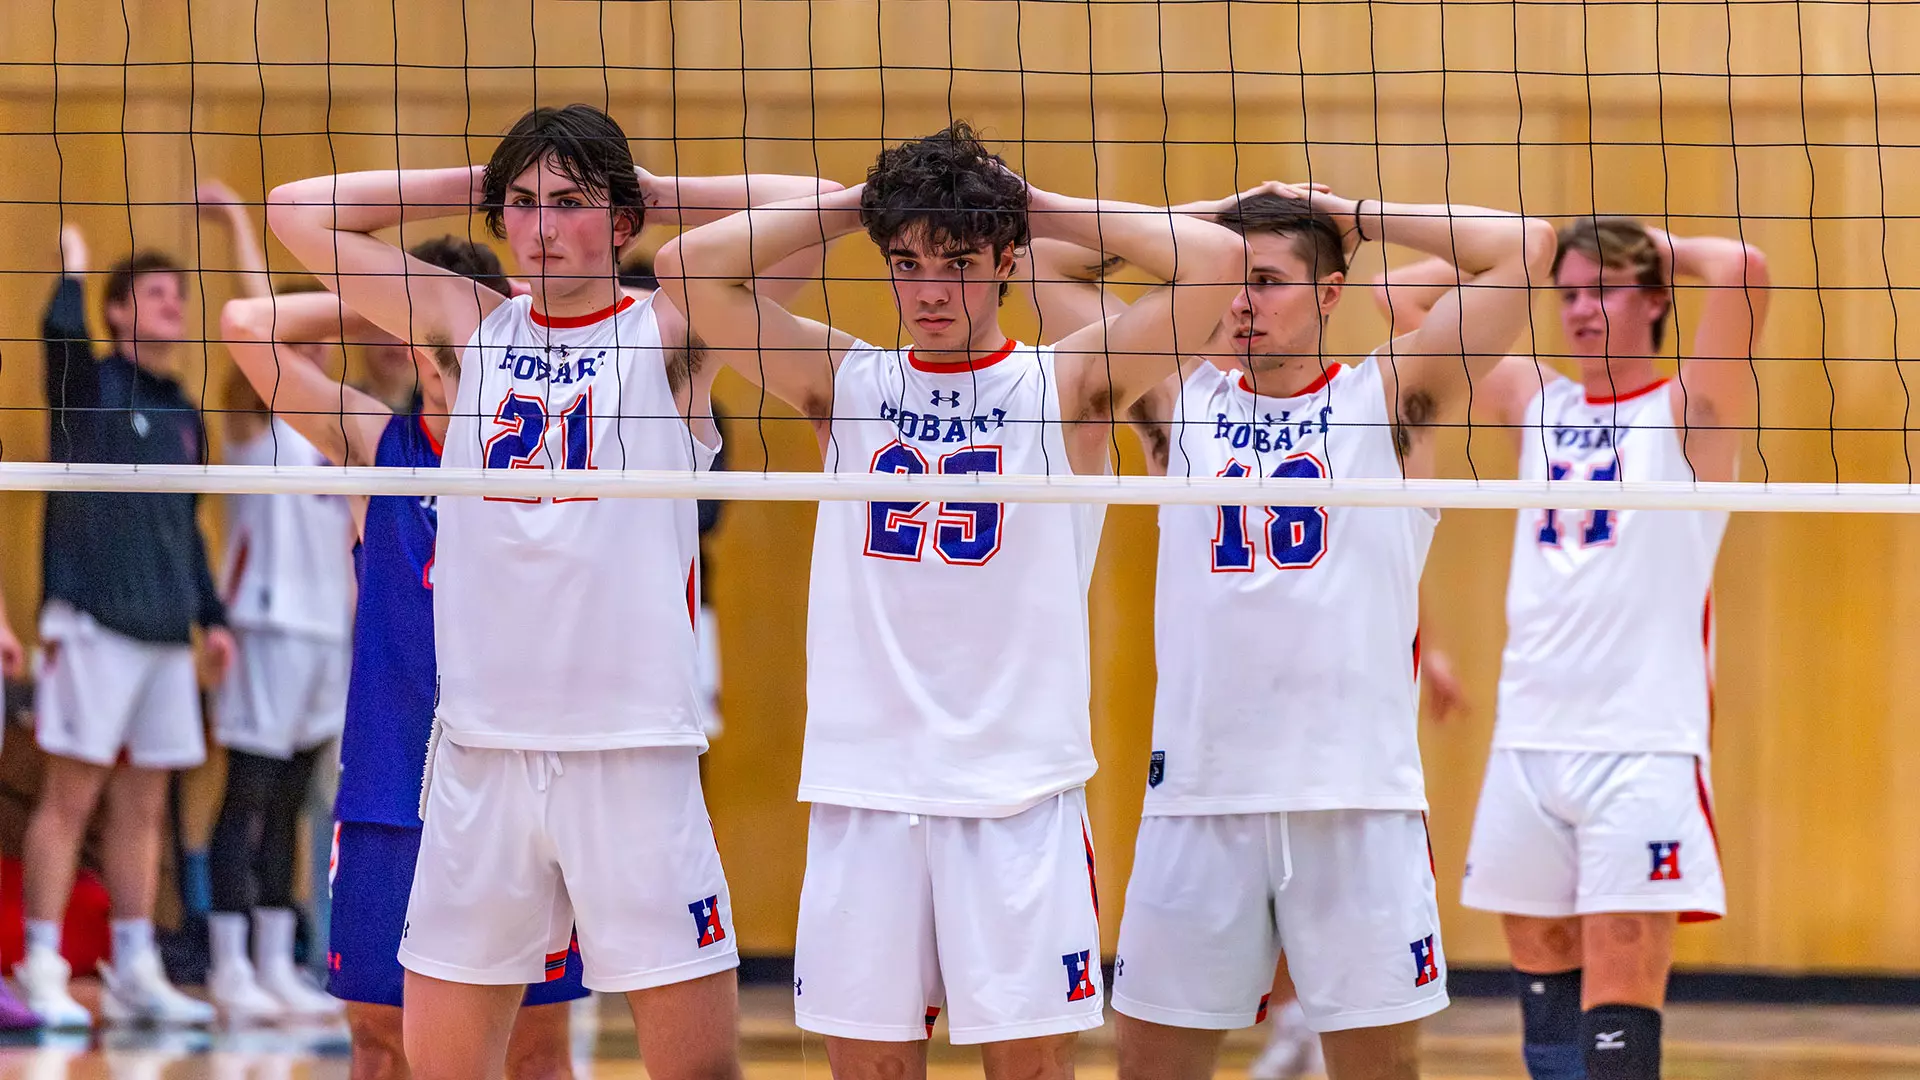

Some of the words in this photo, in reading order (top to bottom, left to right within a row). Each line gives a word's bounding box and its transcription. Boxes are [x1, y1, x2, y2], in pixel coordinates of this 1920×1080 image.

[483, 385, 599, 504] 21
[863, 438, 1005, 567] 25
[1211, 452, 1329, 573] 18
[1648, 840, 1682, 881] H
[688, 895, 726, 949] H
[1062, 949, 1096, 1002] H
[1410, 934, 1438, 988] H
